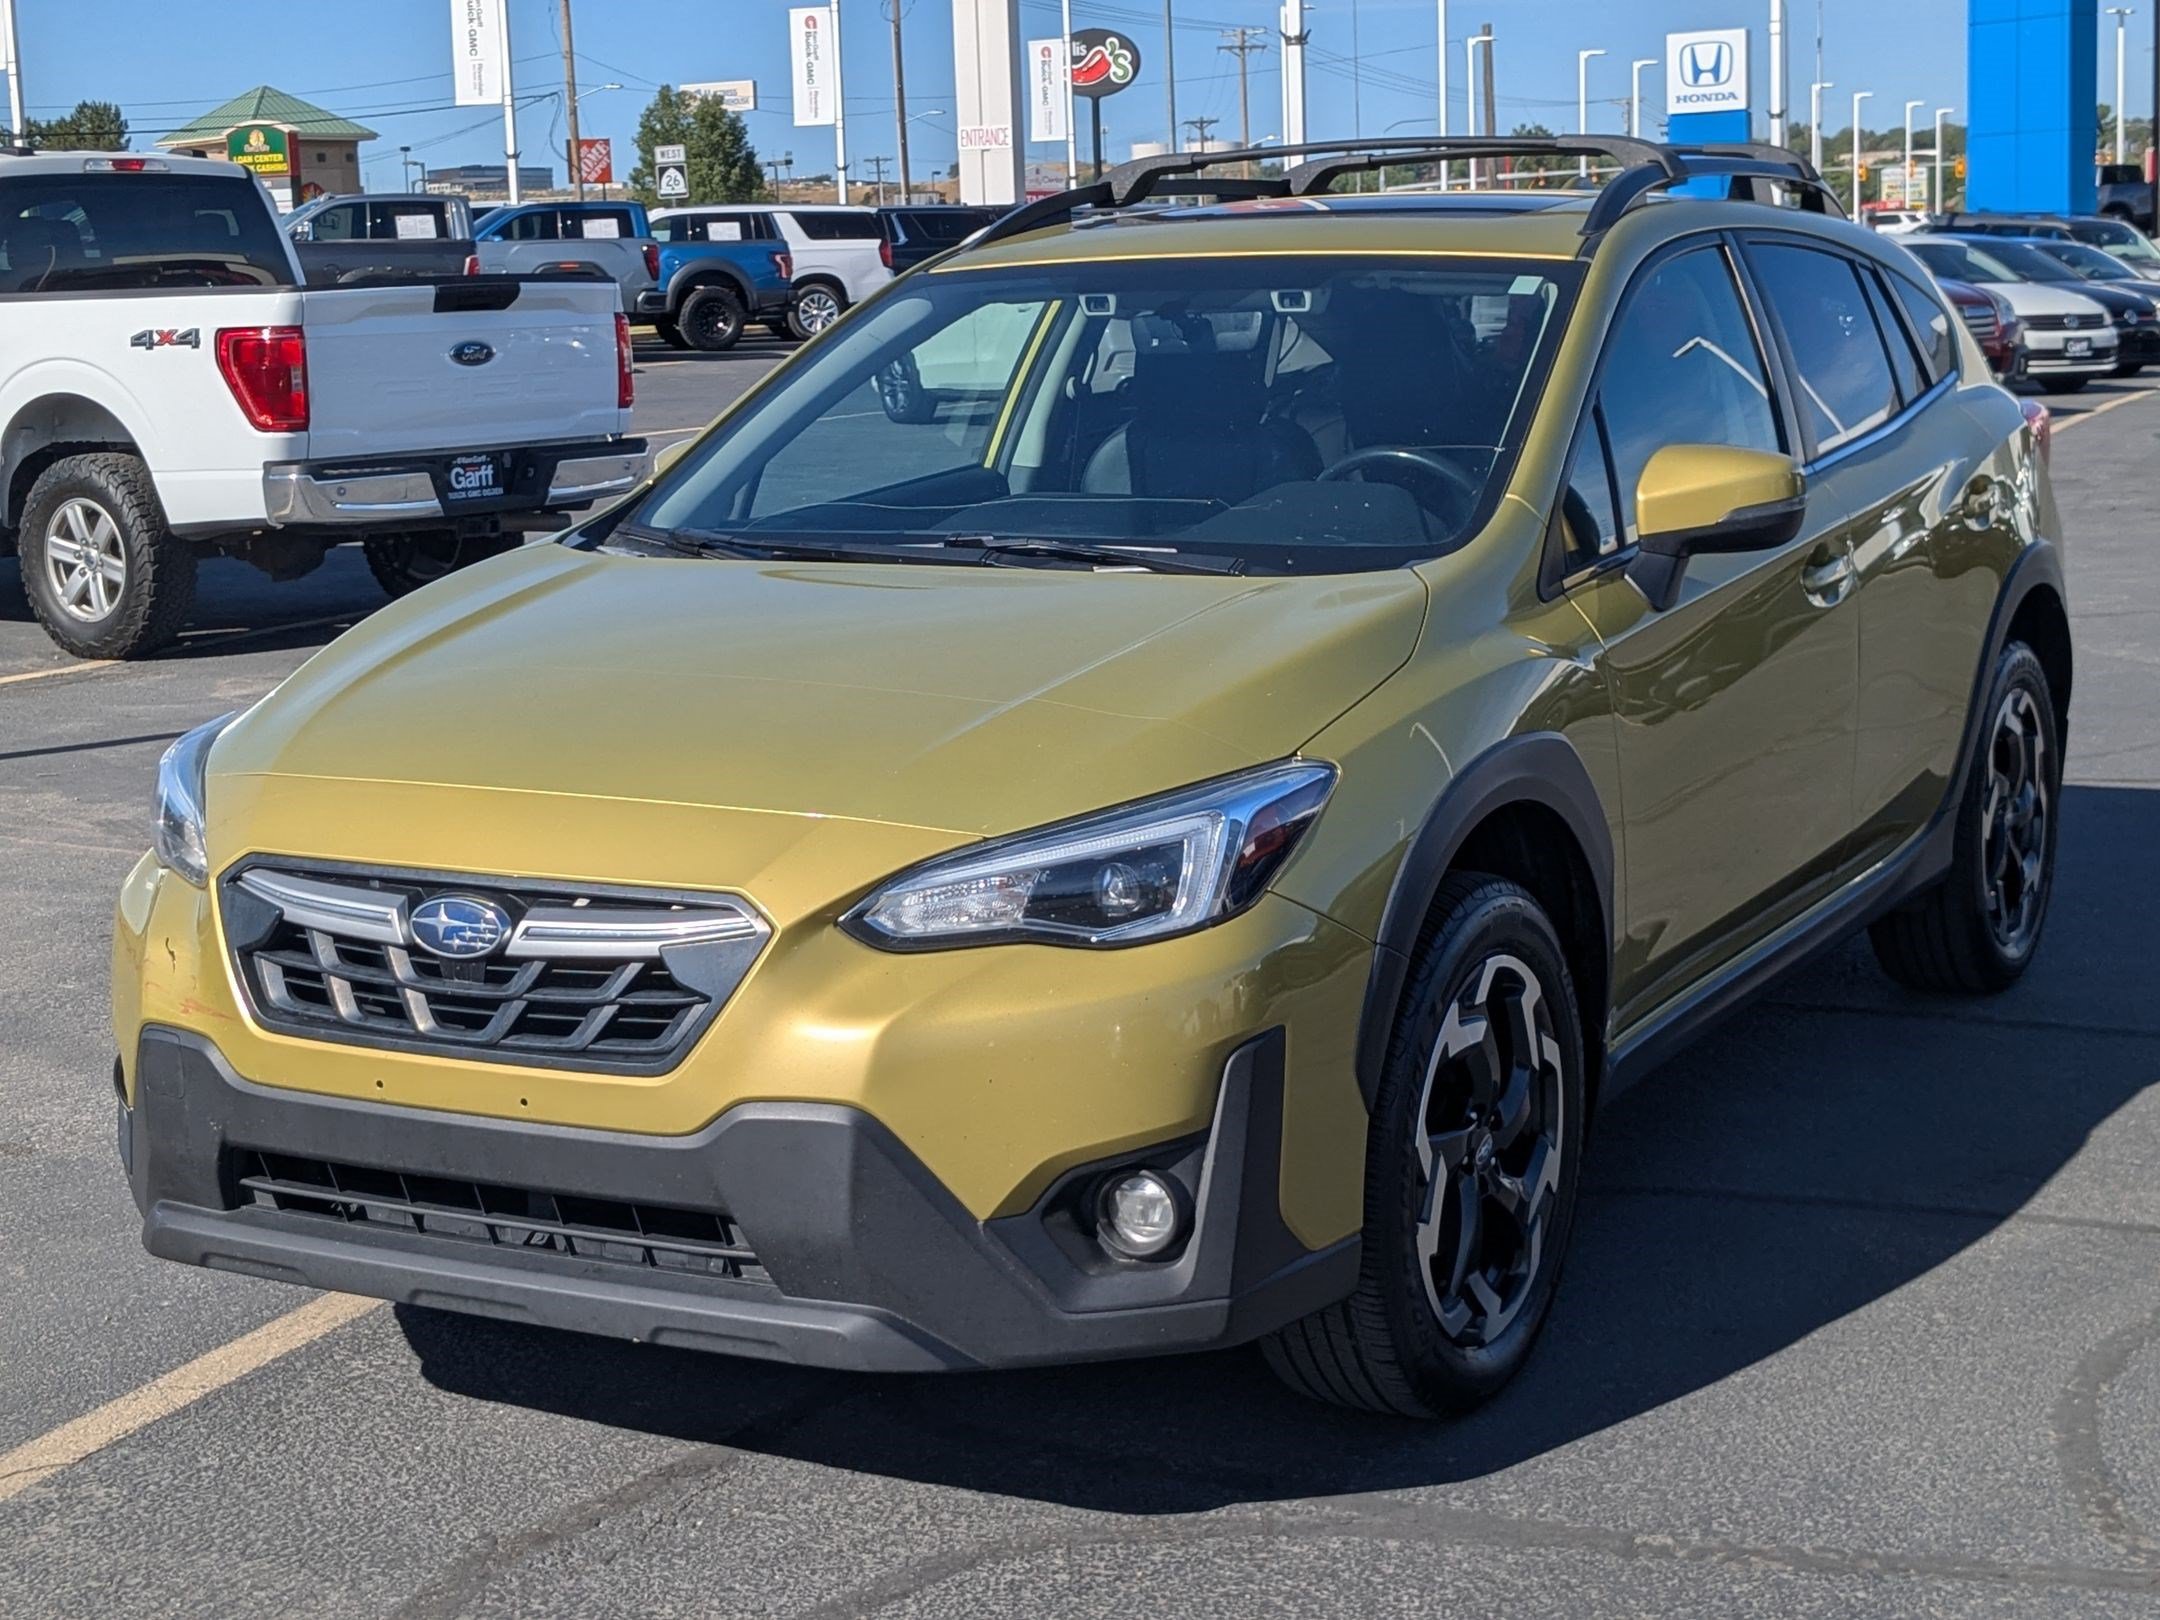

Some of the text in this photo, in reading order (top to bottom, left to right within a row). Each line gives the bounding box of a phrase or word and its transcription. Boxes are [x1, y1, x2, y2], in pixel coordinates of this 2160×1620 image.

[466, 0, 476, 25] uick
[468, 28, 478, 57] GMC
[805, 31, 814, 58] Buick
[806, 61, 815, 86] GMC
[1675, 91, 1739, 104] HONDA
[960, 127, 1009, 148] ENTRANCE
[233, 153, 283, 164] LOAN CENTER
[660, 149, 681, 159] WEST
[665, 174, 681, 187] 26
[450, 464, 494, 489] Garff
